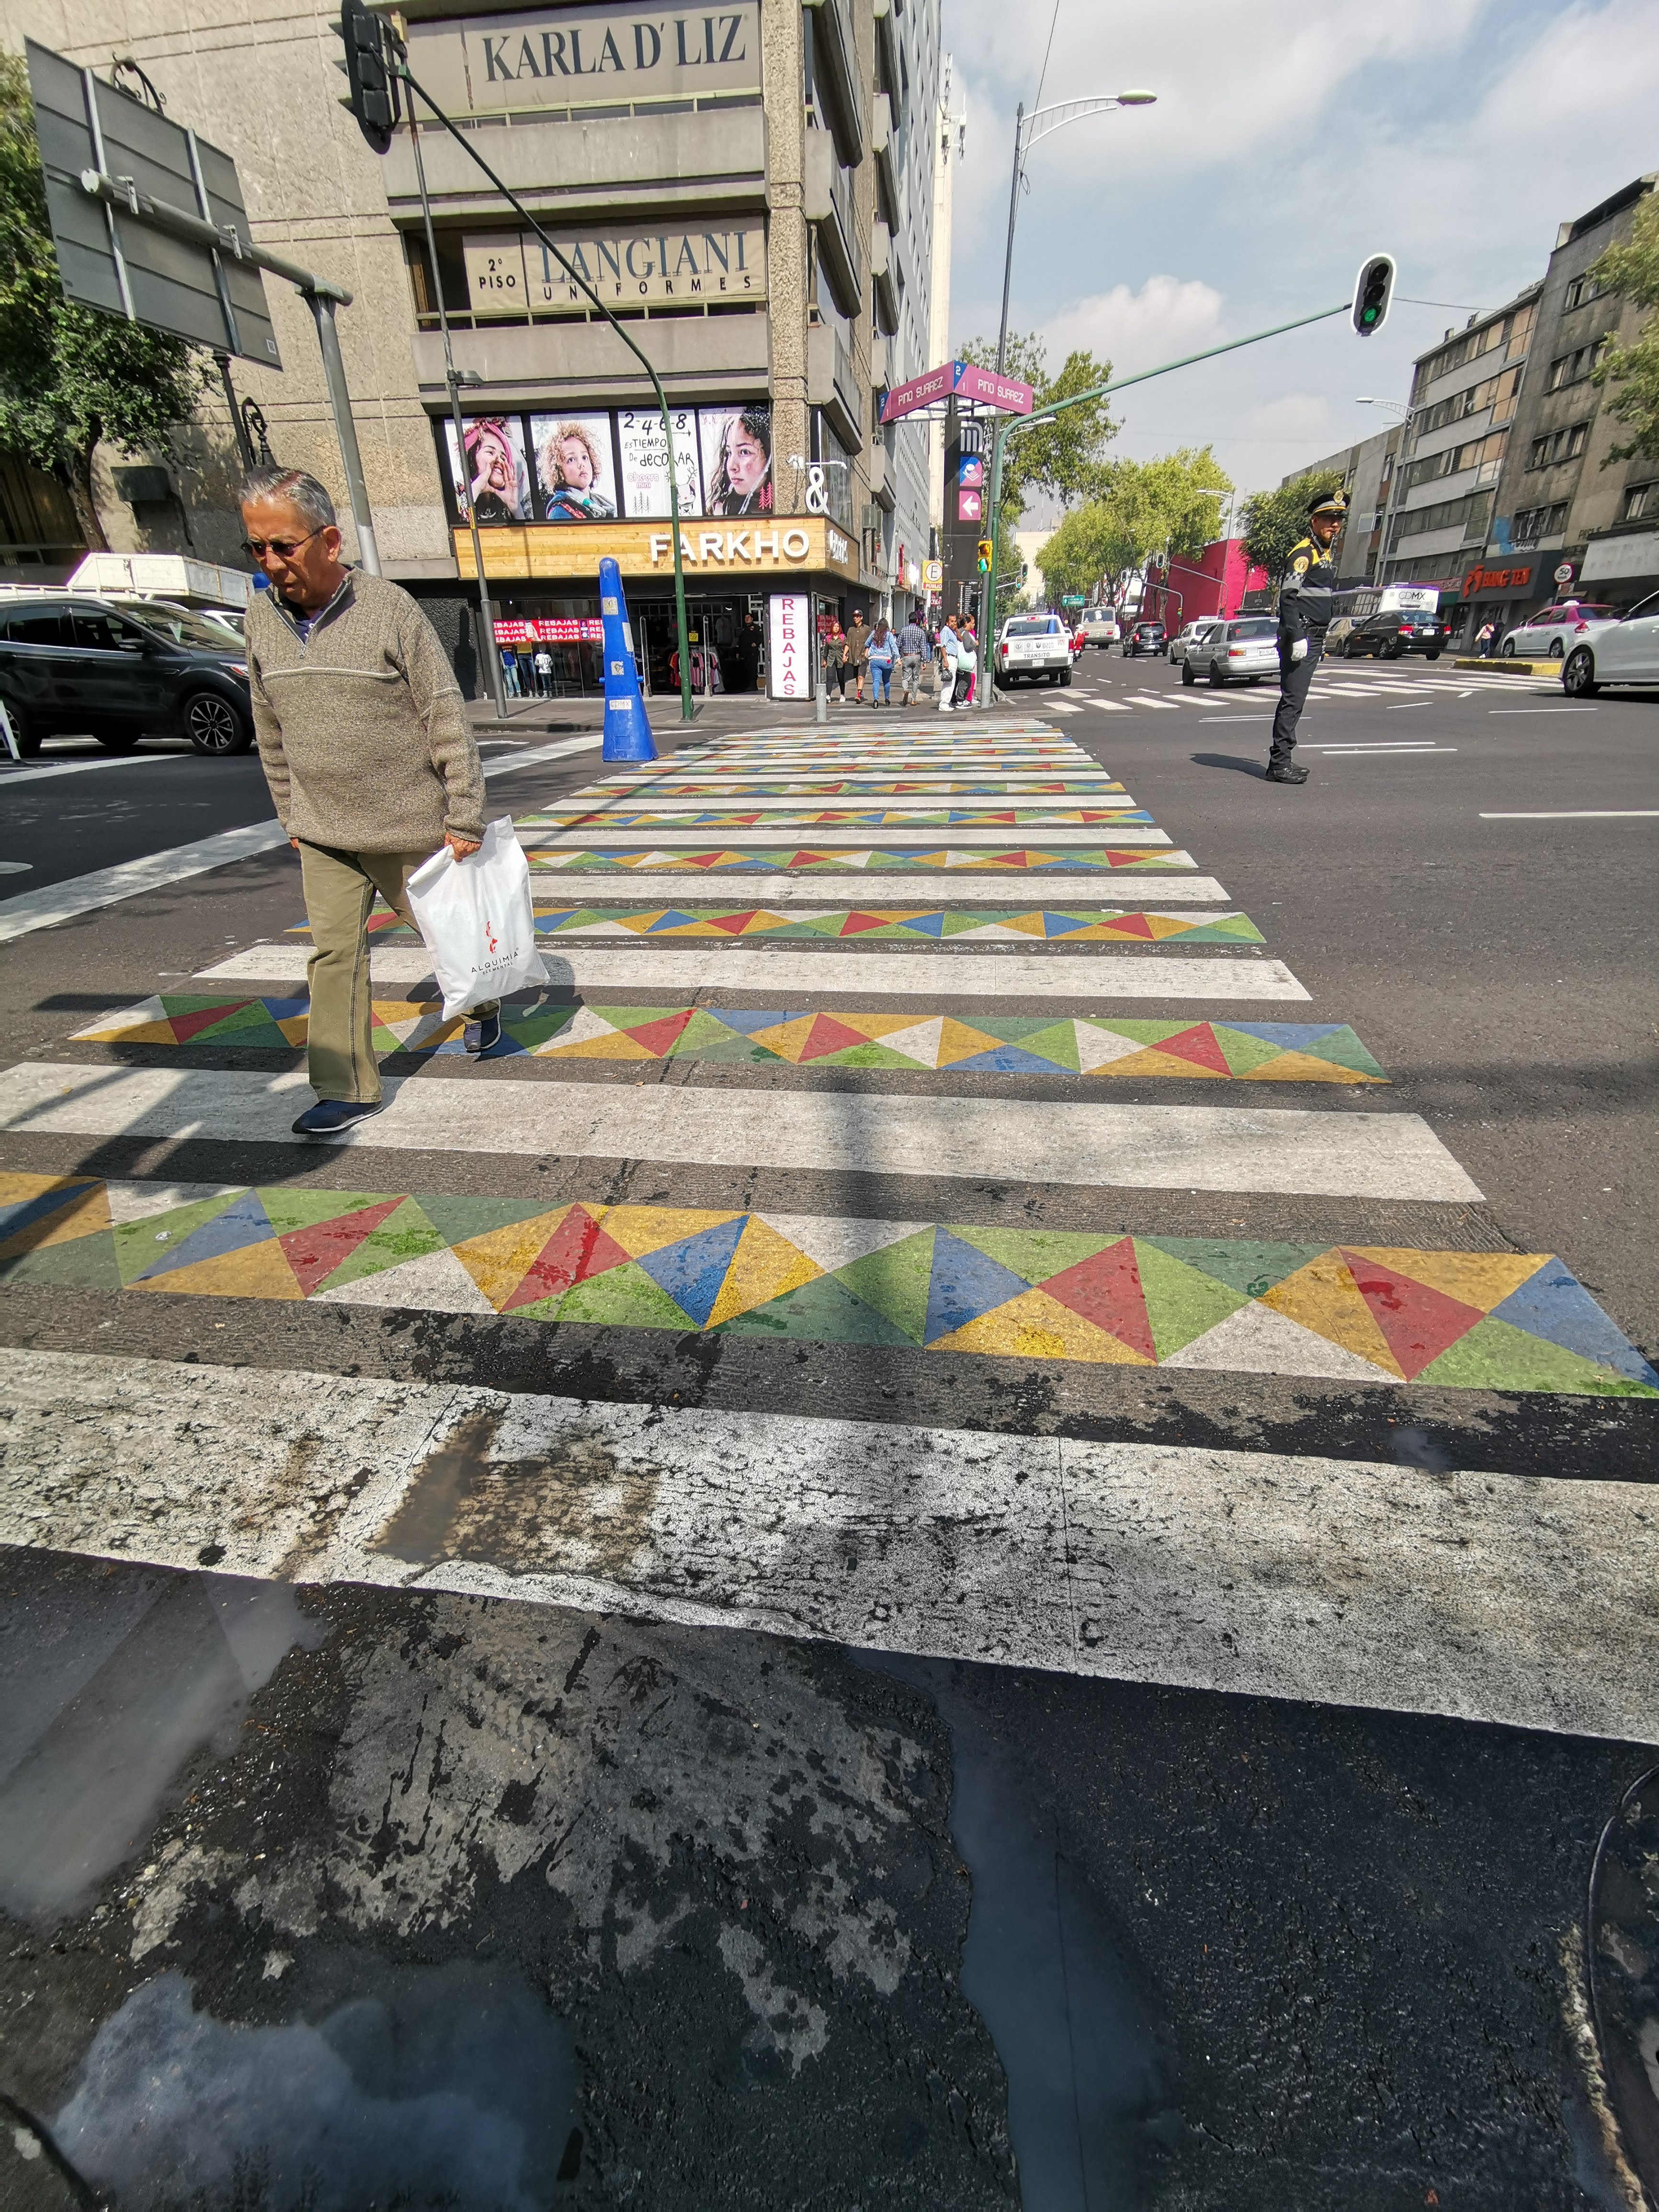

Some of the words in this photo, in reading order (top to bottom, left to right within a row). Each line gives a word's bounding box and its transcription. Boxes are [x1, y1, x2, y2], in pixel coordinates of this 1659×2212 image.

[482, 25, 626, 81] KARLA
[538, 231, 748, 284] LANGIANI
[479, 274, 516, 289] PISO
[543, 276, 751, 300] UNIFORMES
[955, 365, 961, 376] 2
[898, 390, 913, 406] PINO
[916, 376, 943, 398] SUAREZ
[963, 382, 966, 391] 1
[977, 378, 994, 395] PINO
[997, 386, 1024, 404] SUAREZ
[880, 397, 885, 407] 2
[632, 438, 667, 449] TIEMPO
[639, 452, 694, 467] decOAR
[626, 471, 659, 482] Cheers
[650, 529, 810, 561] FARKHO
[1482, 569, 1511, 587] HANG
[1398, 591, 1426, 600] CDMX
[495, 627, 525, 636] EBAJAS
[782, 598, 796, 696] REBAJAS
[471, 951, 519, 973] ALQUIMIA
[482, 961, 513, 975] ELEMENTAL
